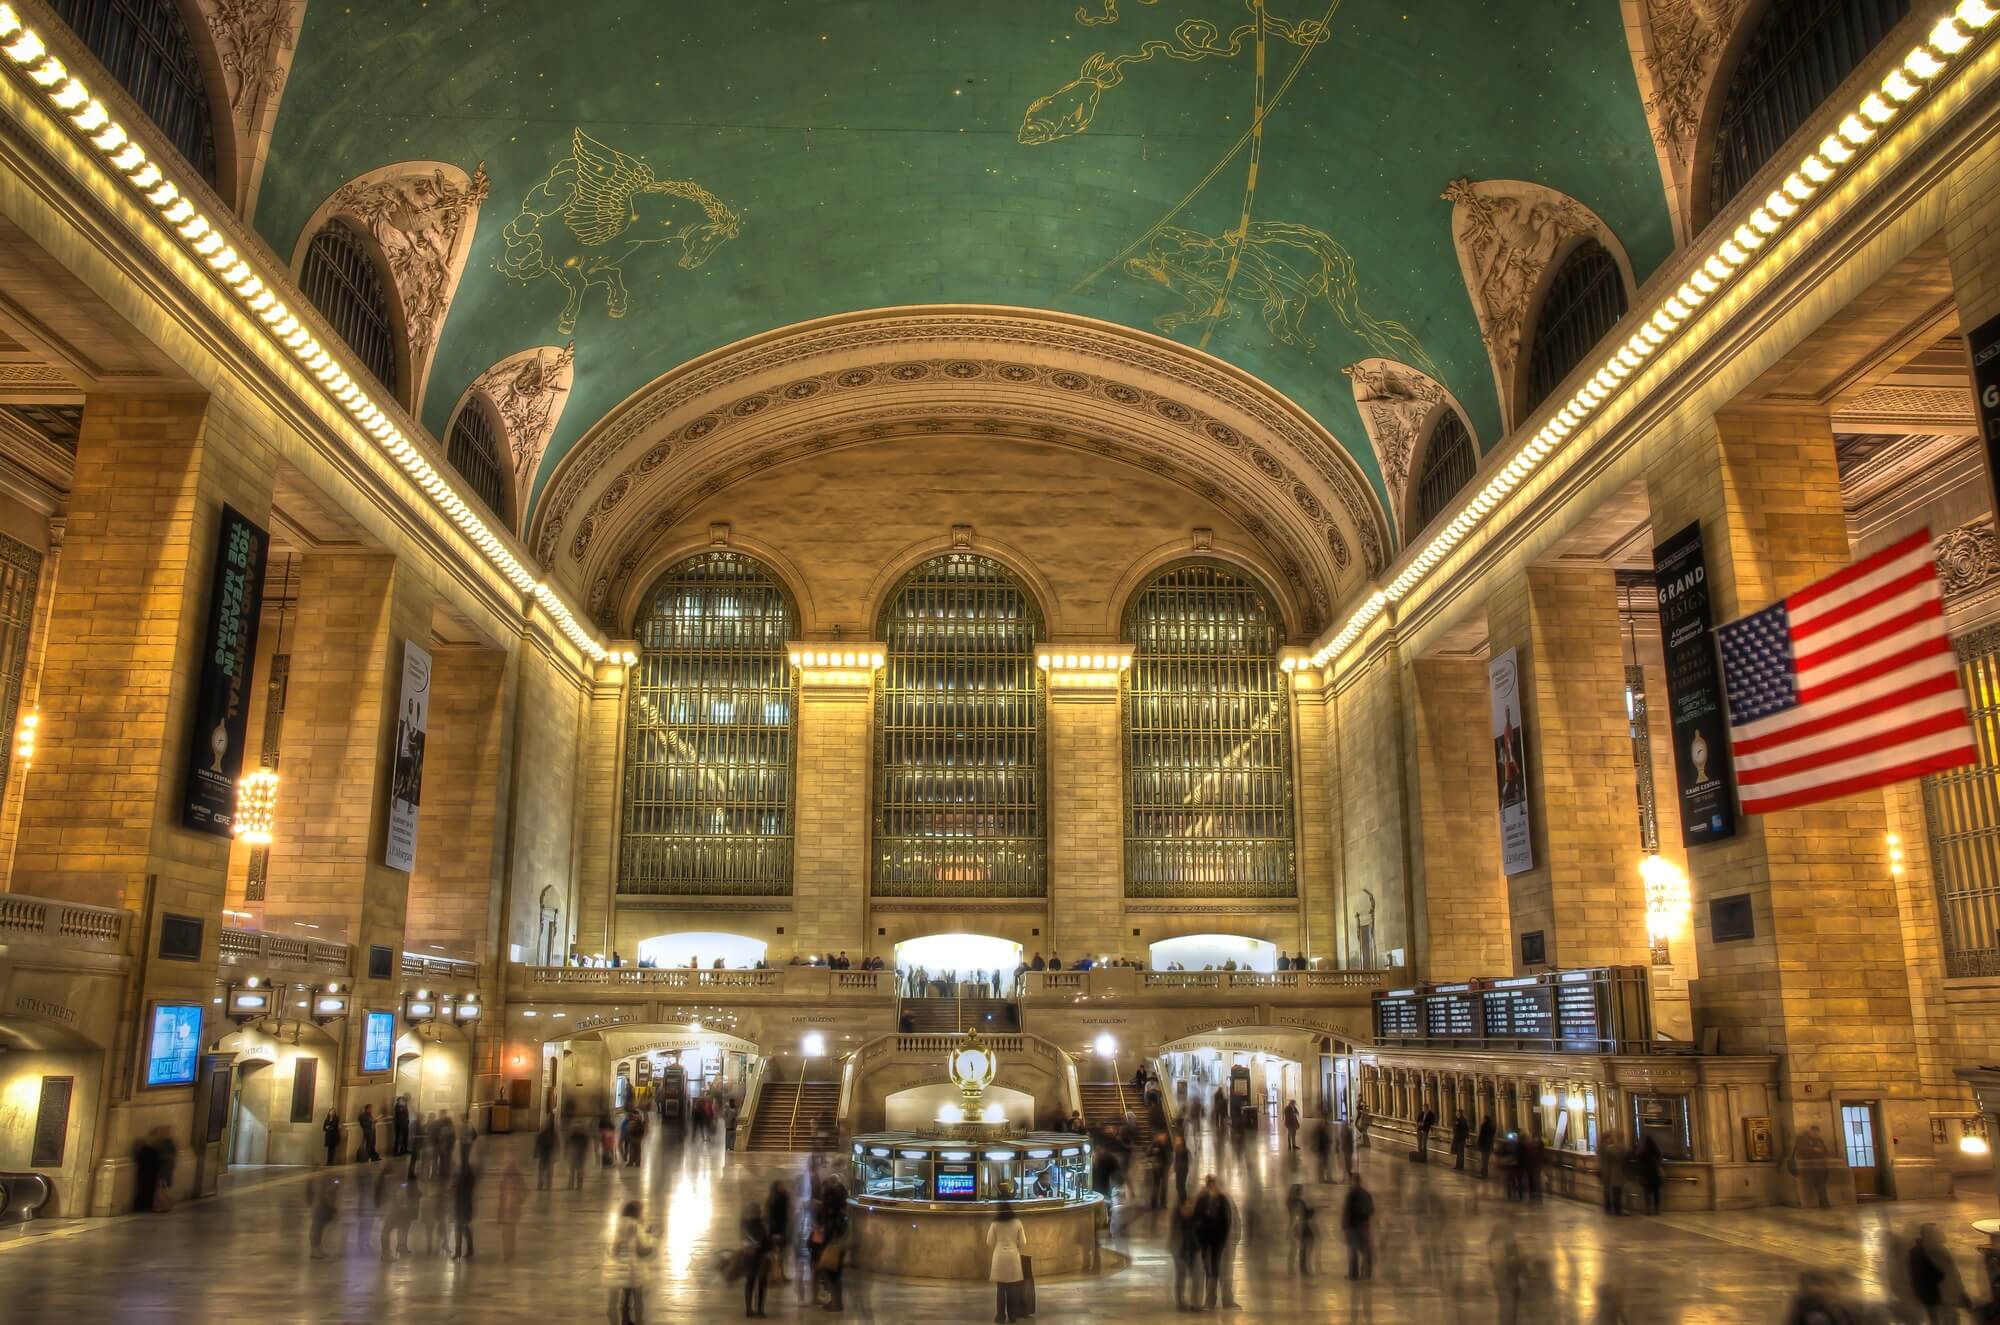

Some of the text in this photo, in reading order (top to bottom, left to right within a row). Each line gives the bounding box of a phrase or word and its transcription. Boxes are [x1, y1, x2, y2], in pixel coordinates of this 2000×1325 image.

[215, 522, 242, 665] THE MAKING
[1659, 566, 1704, 604] GRAND
[223, 528, 250, 677] 100 YEARS IN
[227, 534, 258, 719] GRAND CENTRAL
[41, 1001, 76, 1022] STREET
[576, 1016, 609, 1030] TRACKS
[1186, 1018, 1233, 1033] LEXINGTON
[1280, 1016, 1349, 1033] TICKET MACHINES
[646, 1041, 669, 1050] STREET
[1167, 1042, 1190, 1051] STREET
